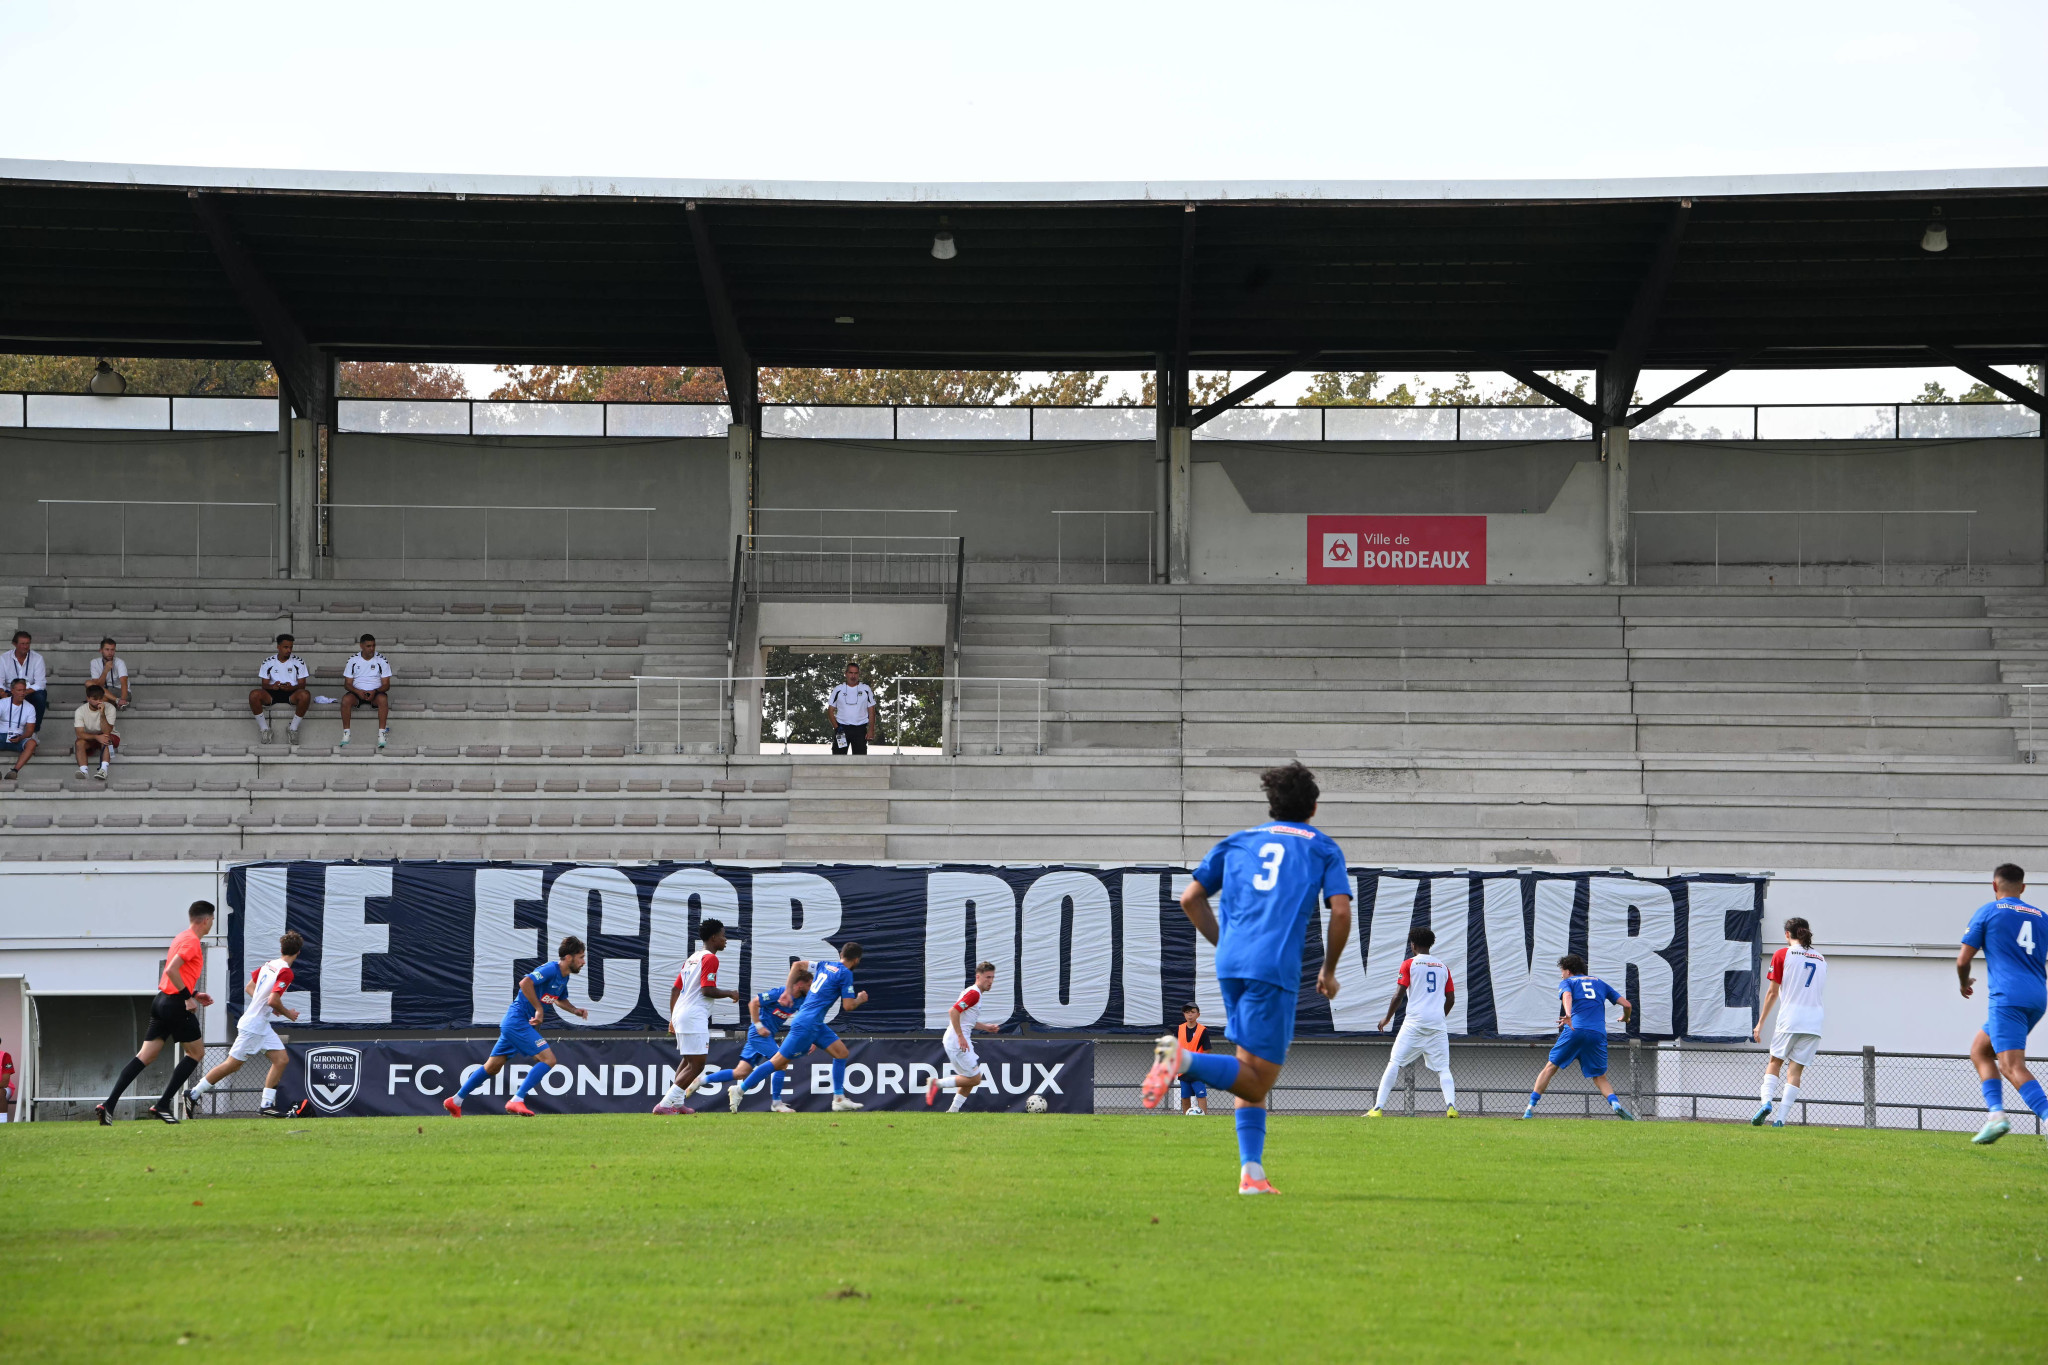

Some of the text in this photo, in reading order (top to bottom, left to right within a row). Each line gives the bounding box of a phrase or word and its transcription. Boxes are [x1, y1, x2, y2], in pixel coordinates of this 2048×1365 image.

[1364, 533, 1410, 545] Ville de
[1363, 551, 1470, 569] BORDEAUX
[1252, 843, 1285, 891] 3
[2016, 920, 2036, 955] 4
[244, 865, 393, 1024] LE
[472, 866, 843, 1027] FCGB
[1319, 876, 1756, 1037] VIVRE
[1426, 971, 1437, 993] 9
[1804, 962, 1817, 987] 7
[1581, 982, 1596, 999] 5
[388, 1063, 445, 1096] FC
